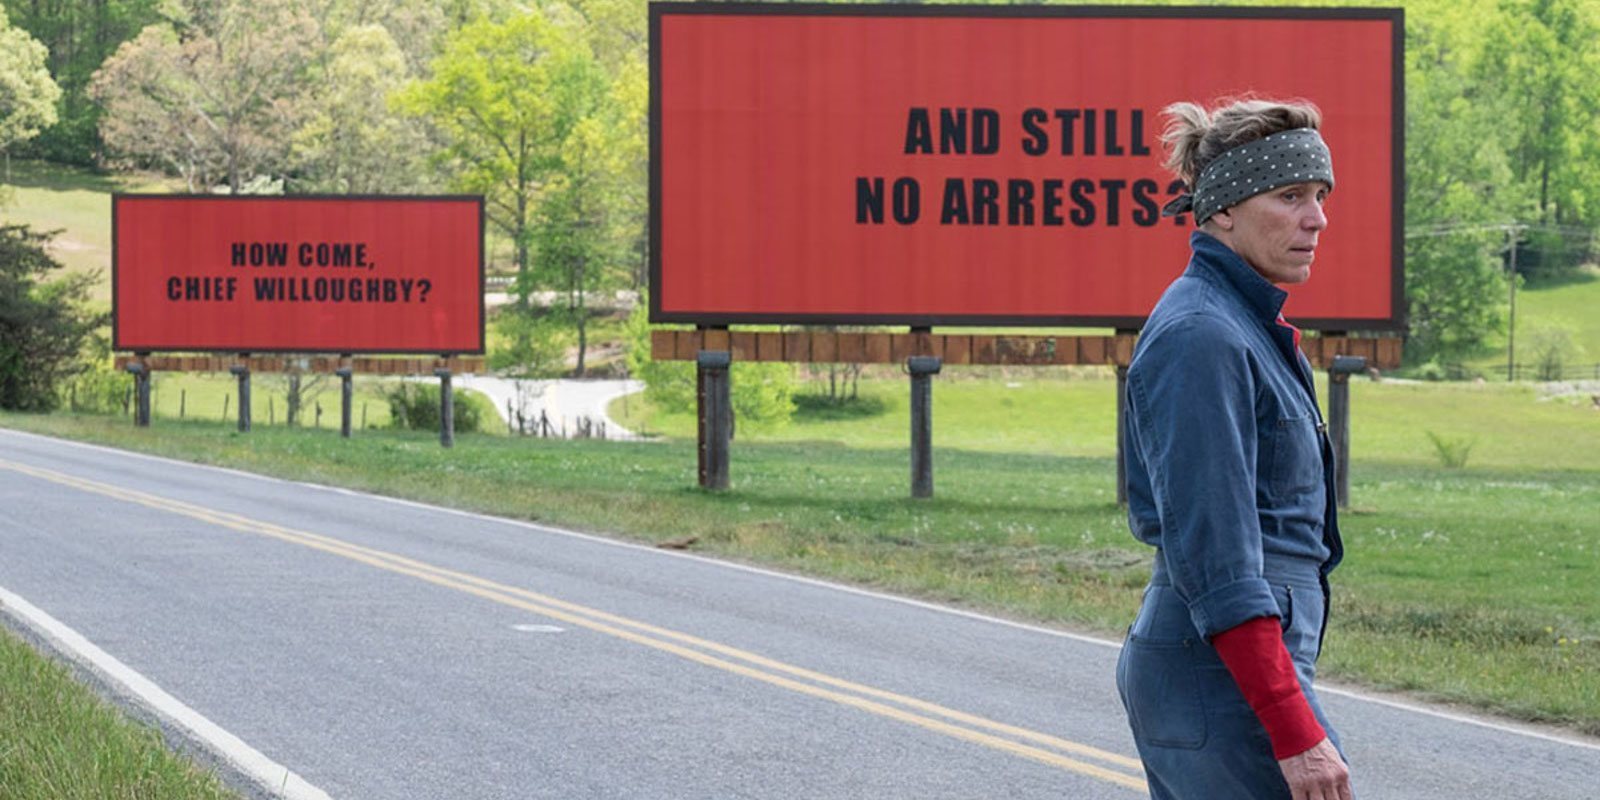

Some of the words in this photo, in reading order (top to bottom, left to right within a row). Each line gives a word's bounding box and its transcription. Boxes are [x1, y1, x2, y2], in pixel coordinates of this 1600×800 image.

[904, 108, 1000, 156] AND
[1021, 108, 1151, 157] STILL
[855, 176, 921, 226] NO
[231, 242, 288, 267] HOW
[298, 242, 376, 270] COME,
[166, 276, 238, 302] CHIEF
[253, 277, 432, 303] WILLOUGHBY?
